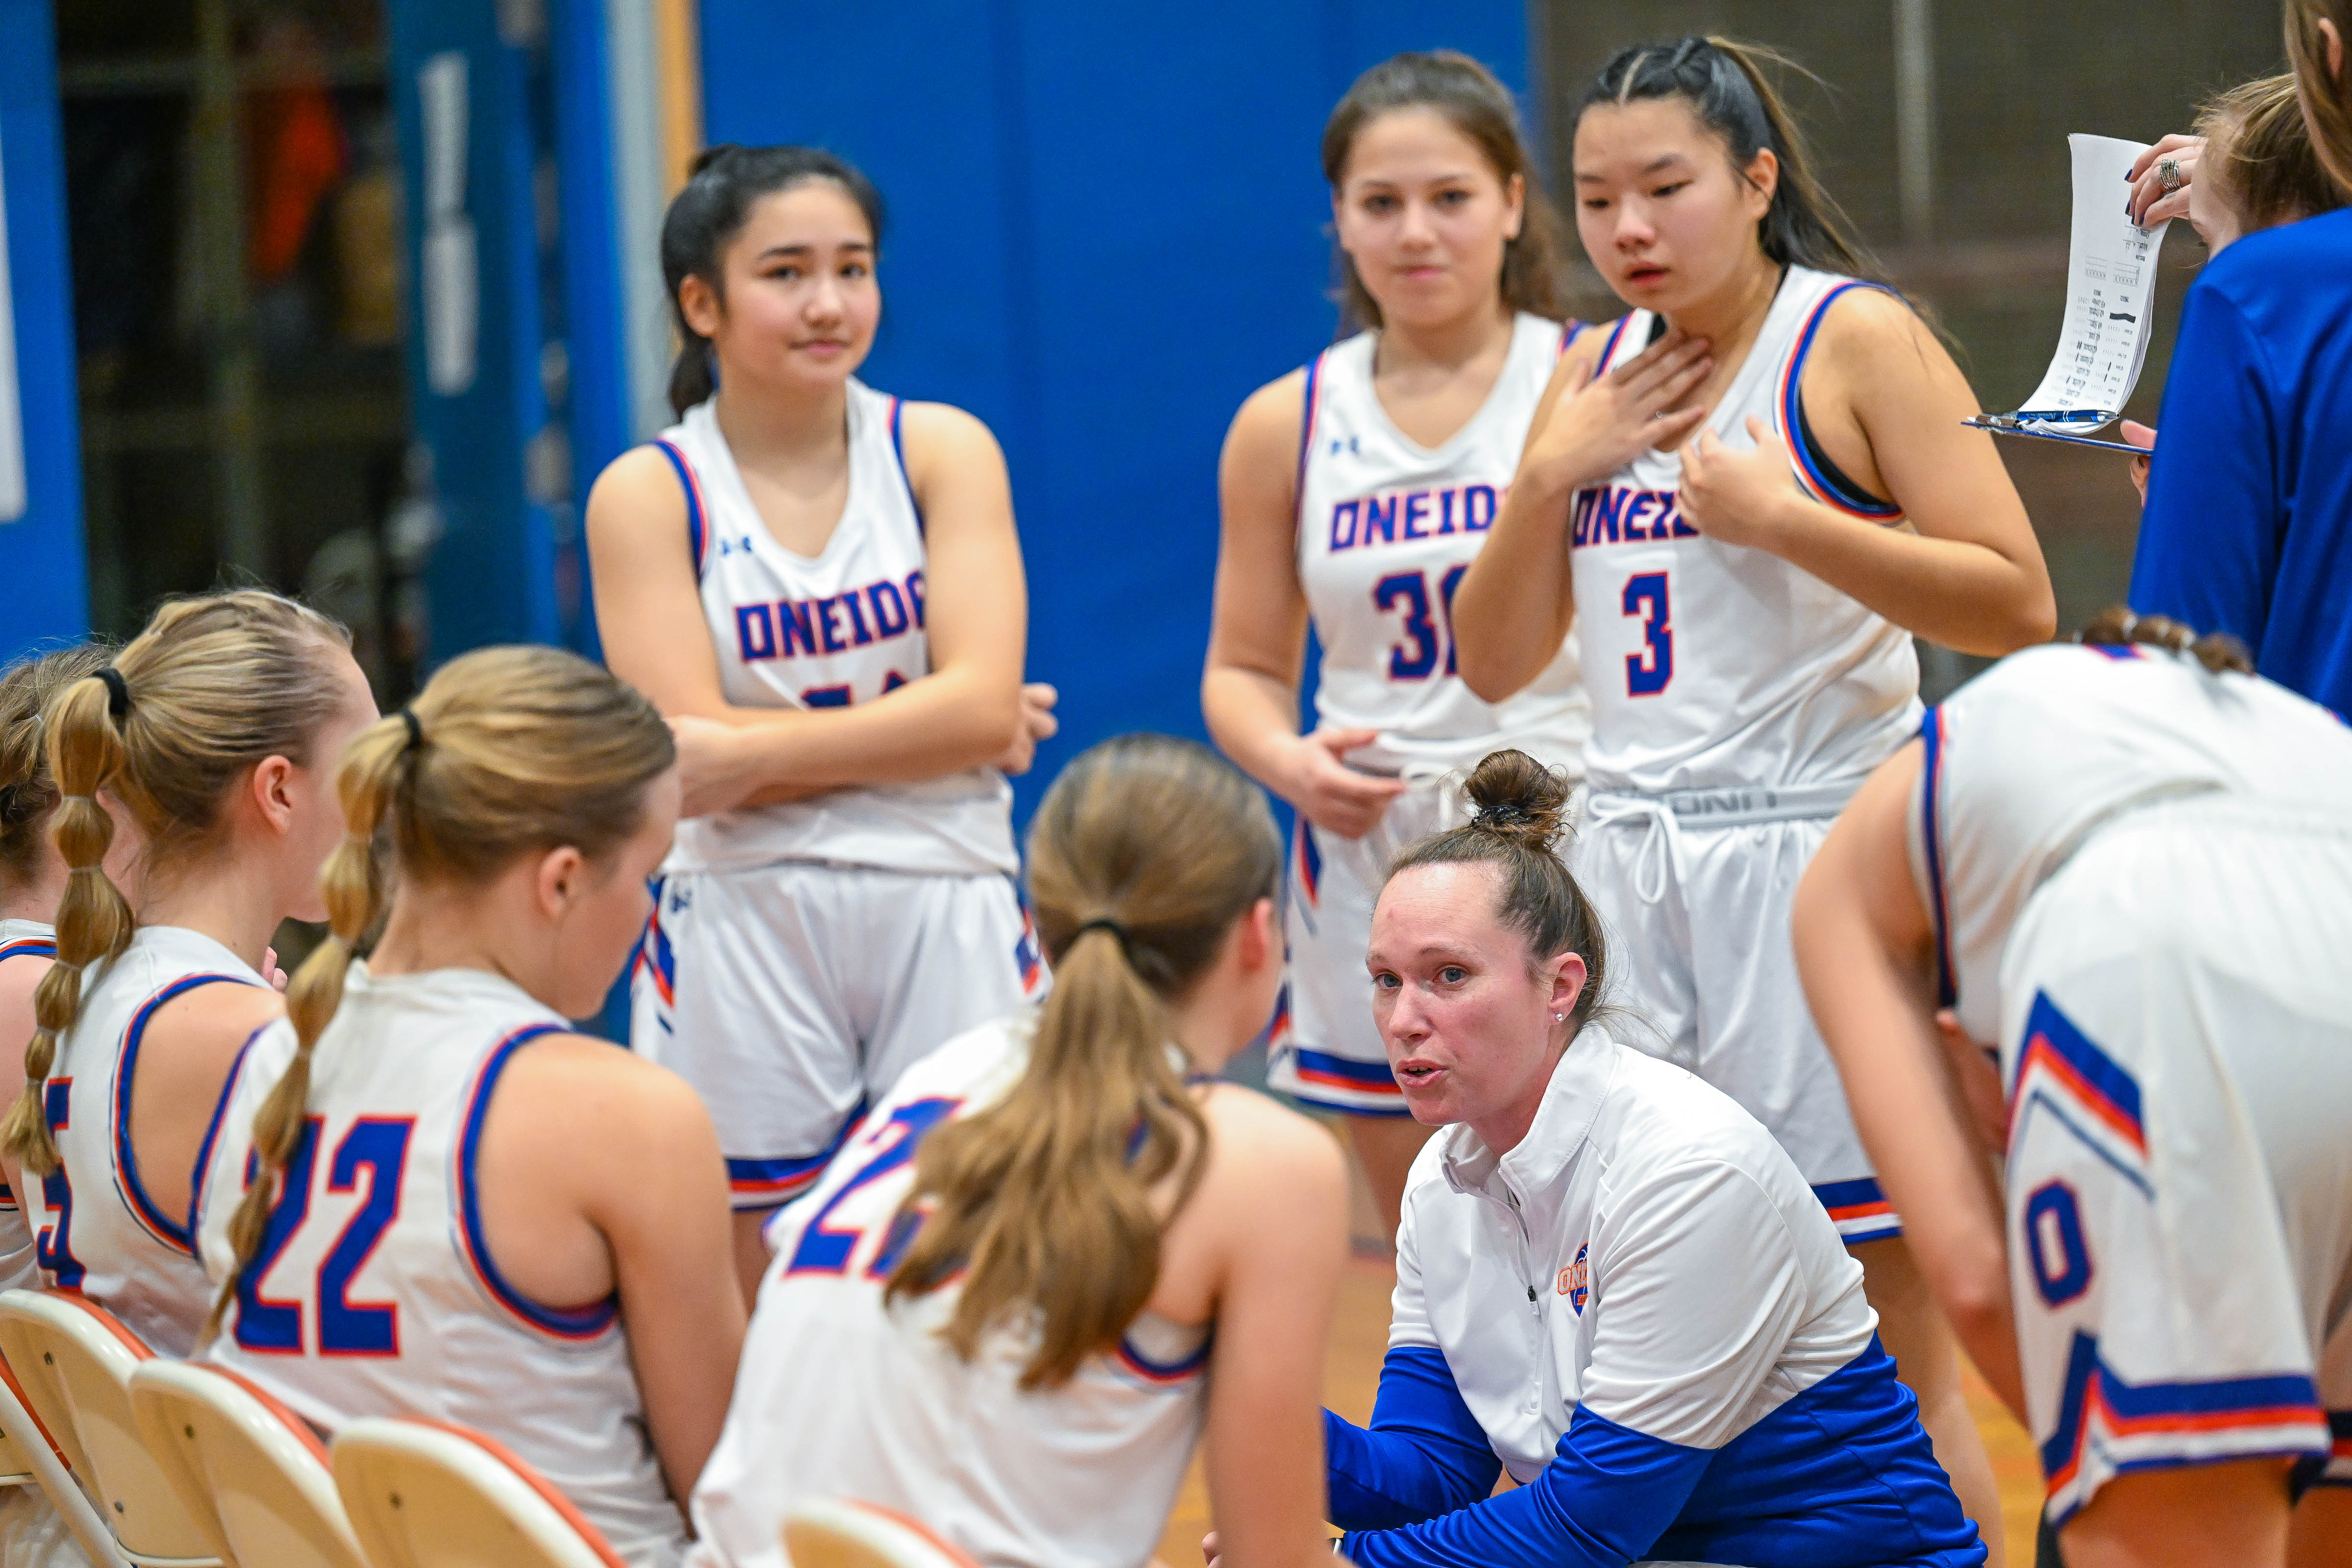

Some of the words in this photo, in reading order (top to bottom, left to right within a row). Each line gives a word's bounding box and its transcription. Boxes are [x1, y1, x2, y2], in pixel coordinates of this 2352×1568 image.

[1329, 483, 1507, 553] ONEID
[1621, 571, 1674, 698] 3
[234, 1112, 418, 1358] 22
